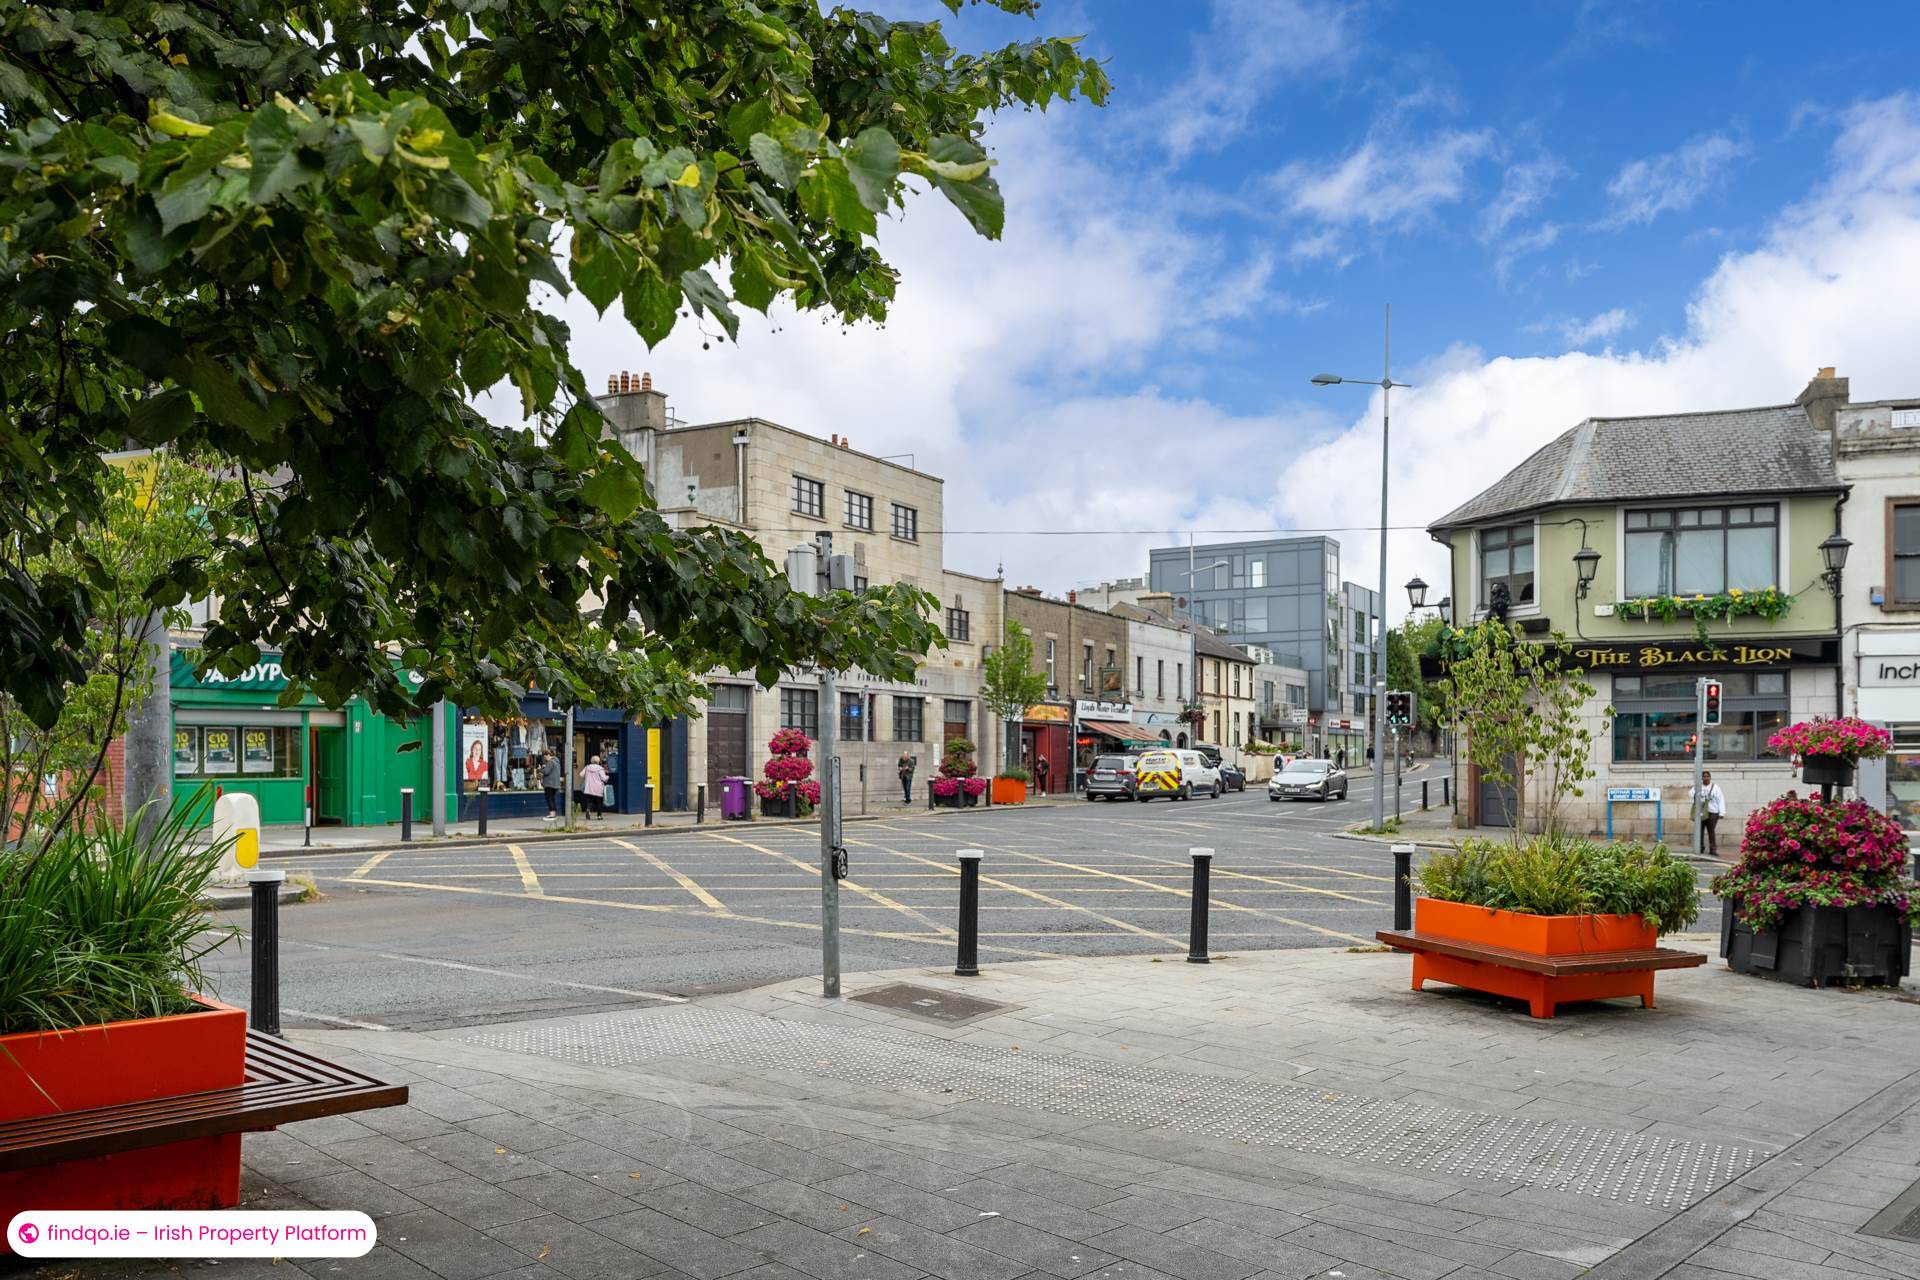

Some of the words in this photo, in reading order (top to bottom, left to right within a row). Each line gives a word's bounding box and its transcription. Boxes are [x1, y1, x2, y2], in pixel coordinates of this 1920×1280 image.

[1575, 648, 1631, 668] THE
[1639, 647, 1729, 667] BLACK
[1733, 646, 1793, 665] LION
